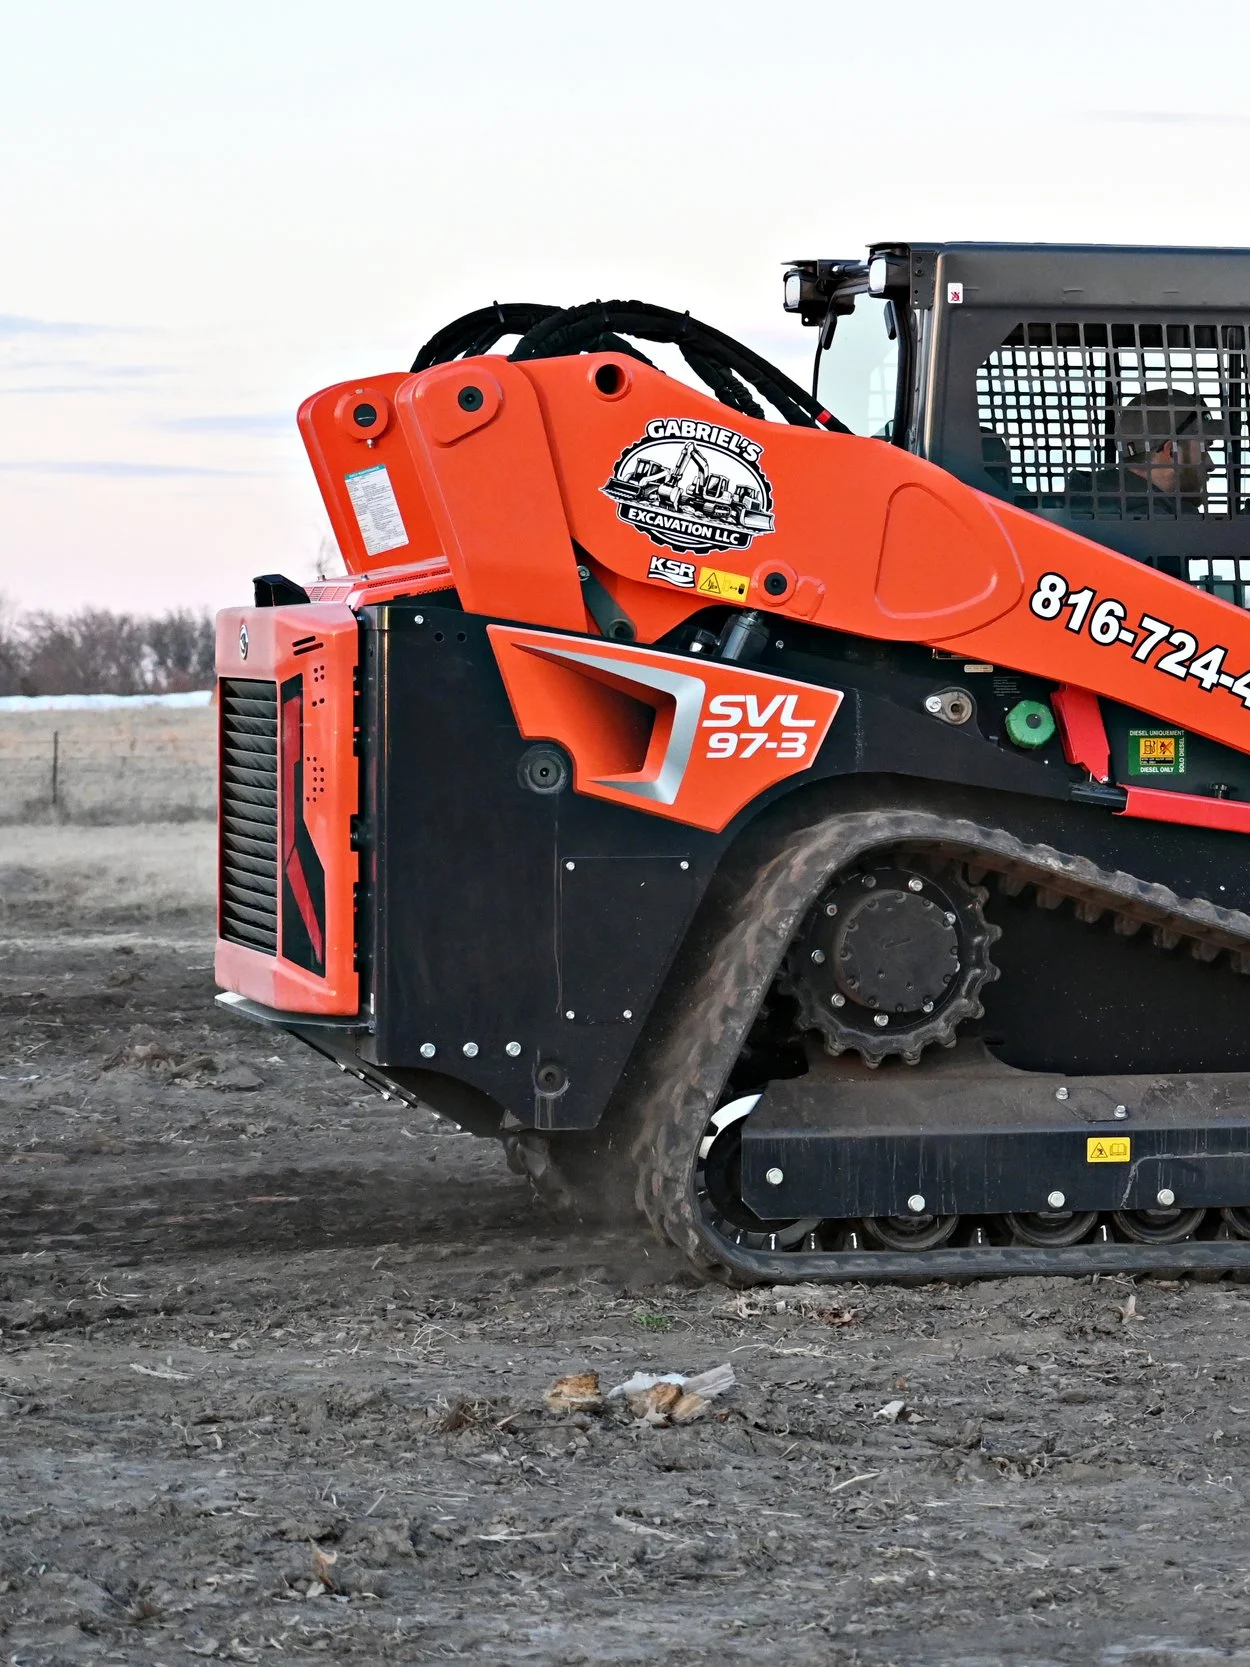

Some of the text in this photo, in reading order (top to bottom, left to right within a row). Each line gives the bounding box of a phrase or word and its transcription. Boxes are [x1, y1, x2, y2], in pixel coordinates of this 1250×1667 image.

[647, 419, 763, 462] GABRIEL'S
[627, 509, 740, 545] EXCAVATION LLC
[650, 556, 695, 578] KSR
[702, 694, 817, 728] SVL
[706, 732, 808, 759] 97-3
